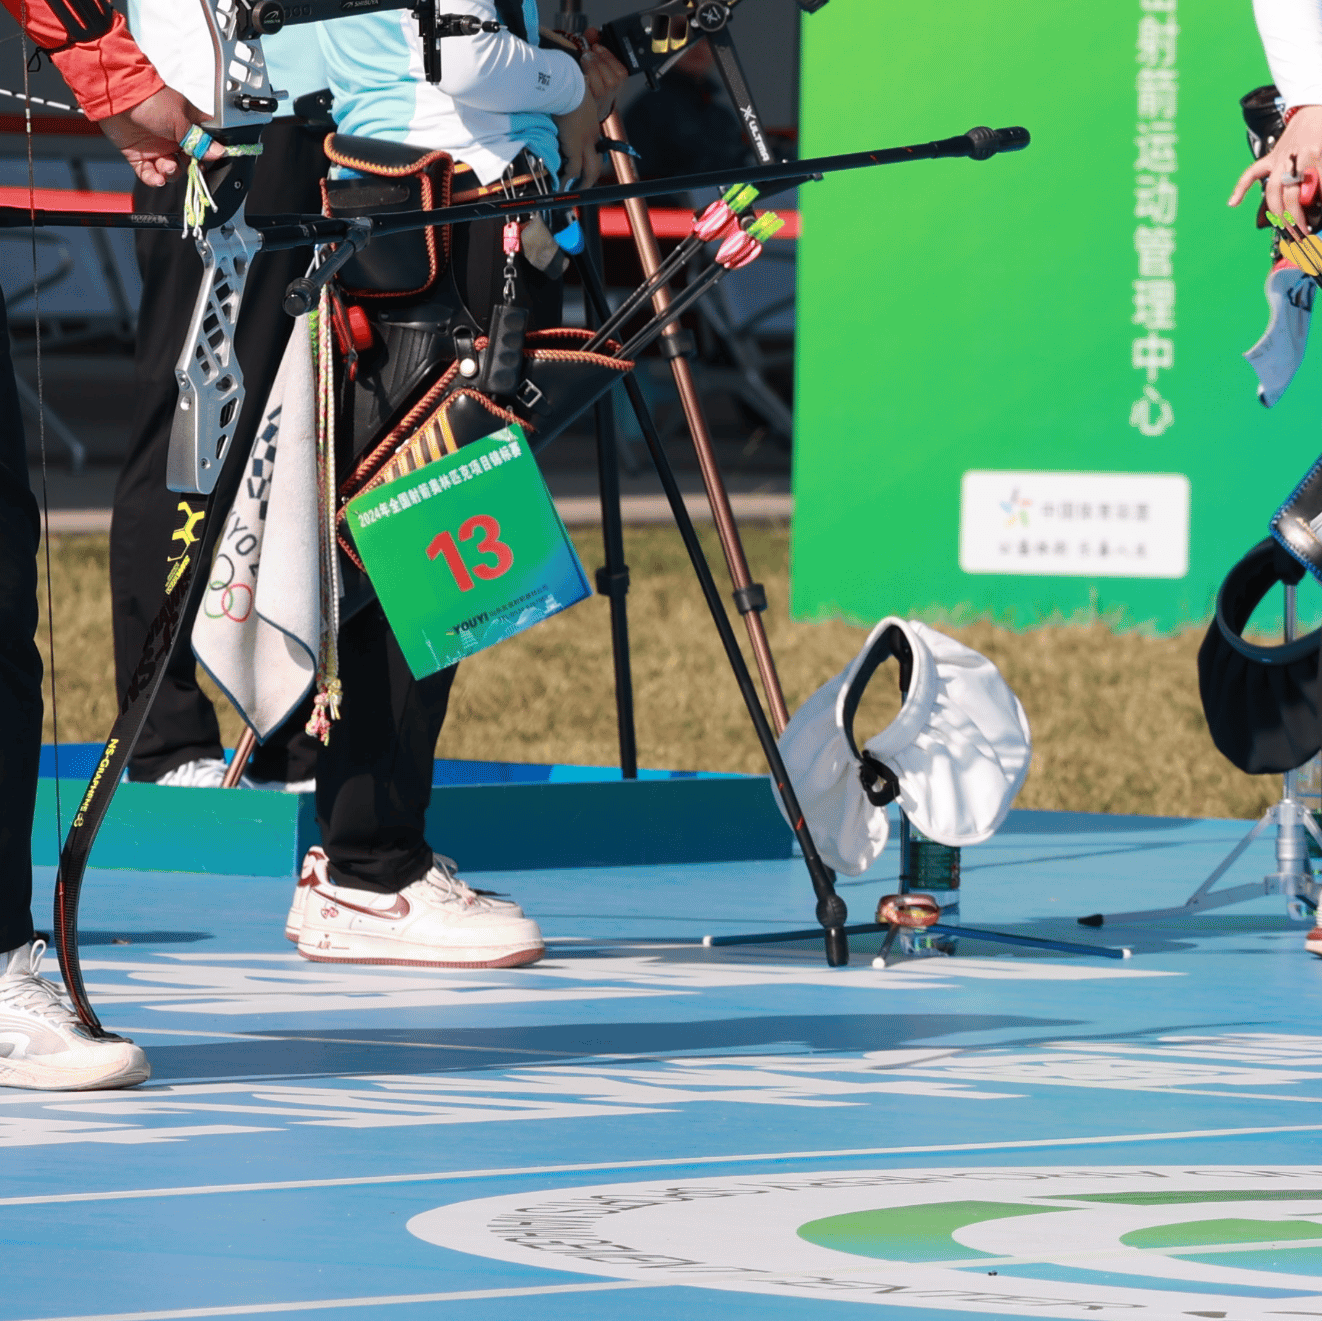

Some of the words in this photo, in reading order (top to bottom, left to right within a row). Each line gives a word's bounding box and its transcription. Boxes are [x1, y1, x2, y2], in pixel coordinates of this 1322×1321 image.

[425, 514, 515, 593] 13
[453, 610, 490, 636] YOUYI
[316, 939, 332, 951] AIR
